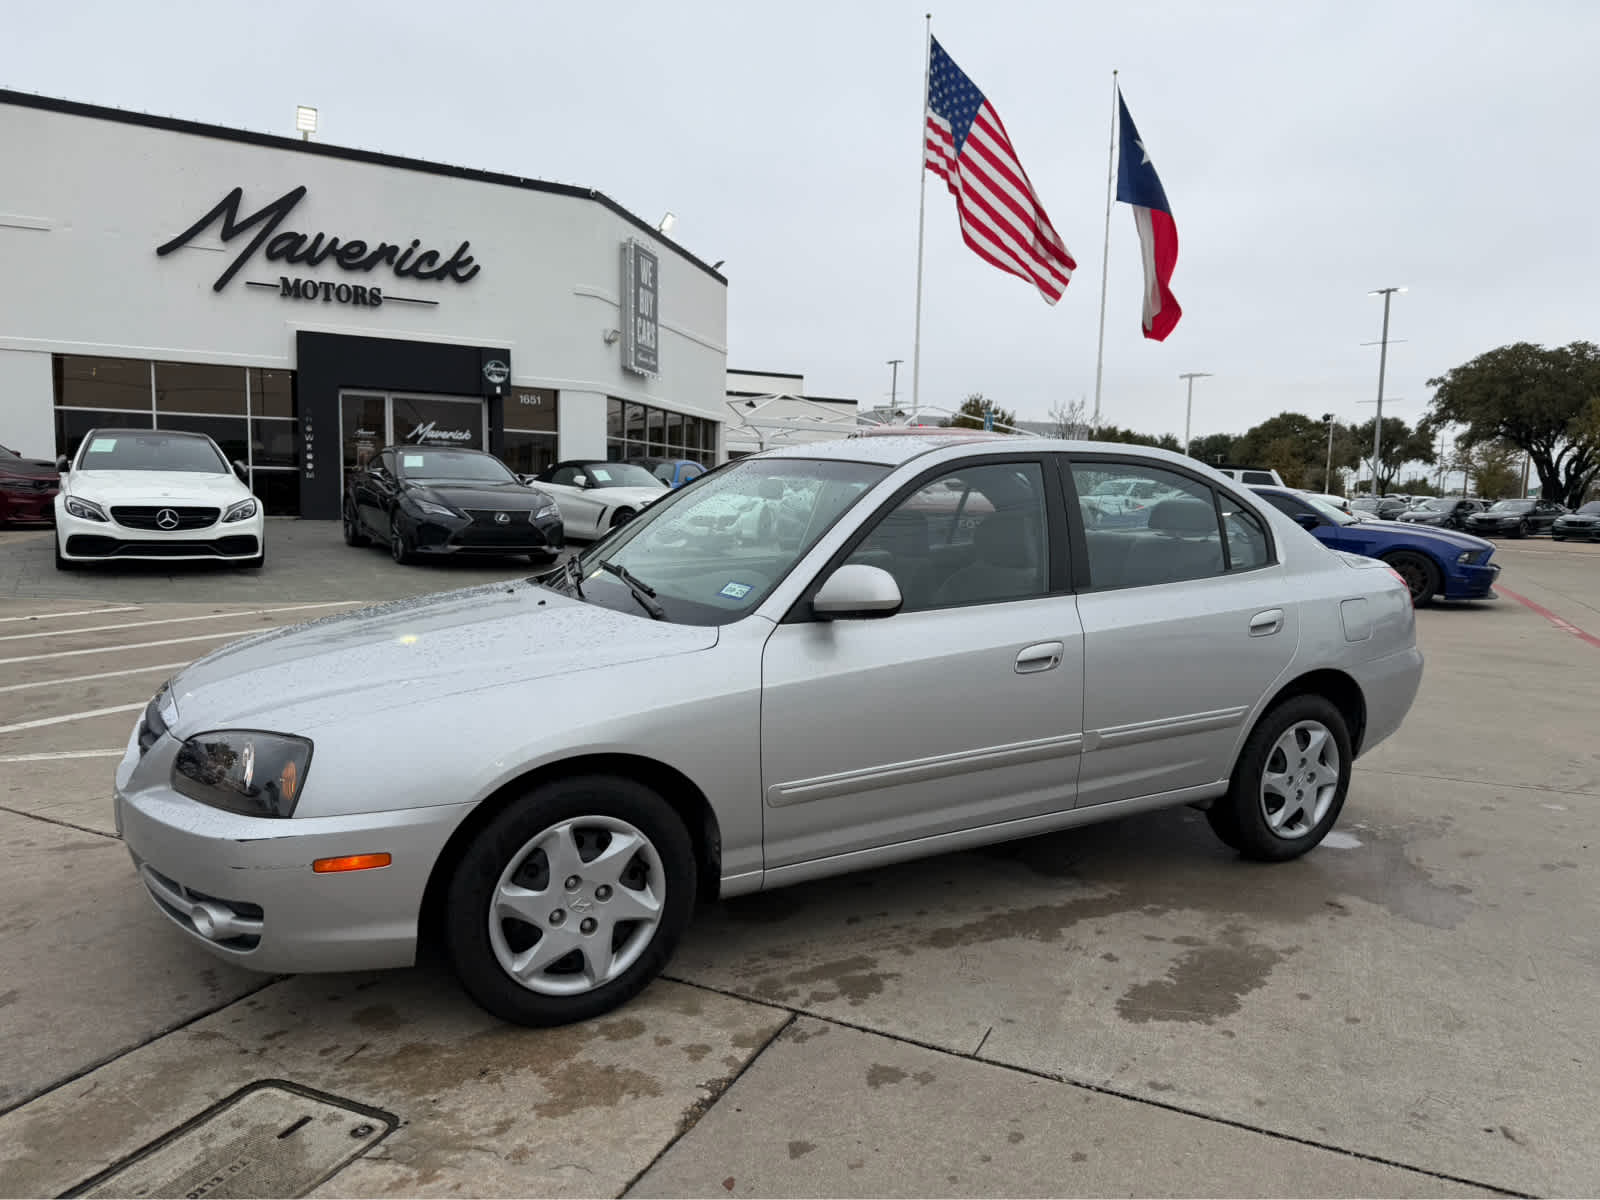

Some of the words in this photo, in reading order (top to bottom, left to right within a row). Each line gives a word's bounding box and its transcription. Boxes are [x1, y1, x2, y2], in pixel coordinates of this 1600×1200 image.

[157, 185, 481, 293] Maverick
[640, 255, 653, 288] WE
[279, 276, 383, 306] MOTORS
[639, 286, 654, 318] BUY
[637, 316, 656, 350] CARS
[520, 394, 541, 405] 1651
[304, 408, 315, 479] HOWROOM
[406, 421, 472, 444] Maverick
